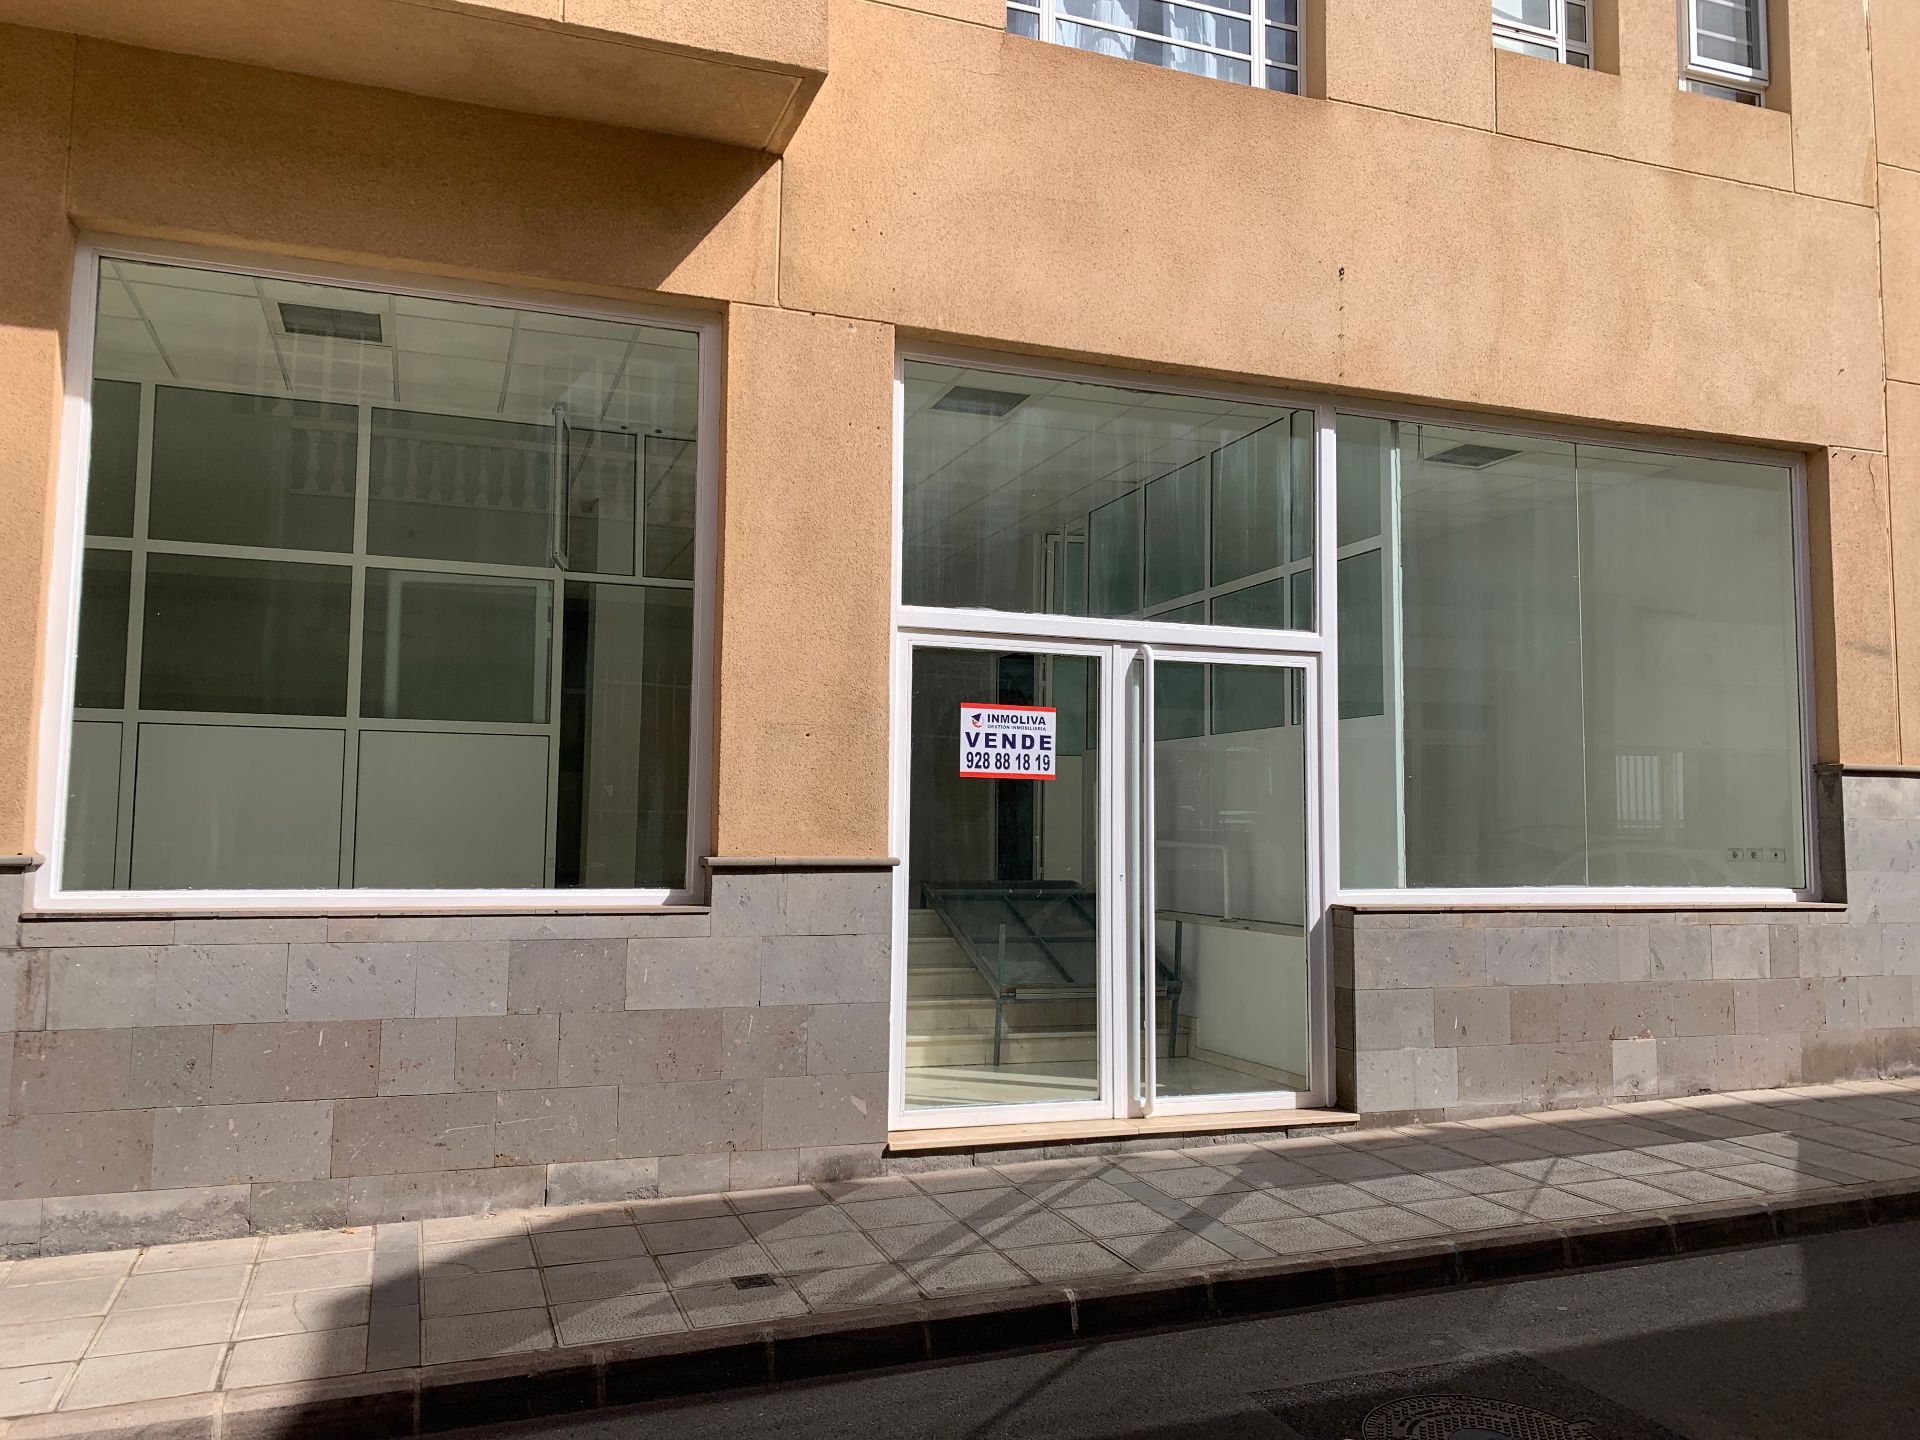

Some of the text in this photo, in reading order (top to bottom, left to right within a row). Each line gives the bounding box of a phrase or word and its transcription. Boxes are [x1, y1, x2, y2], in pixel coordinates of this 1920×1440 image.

[987, 713, 1046, 725] INMOLIVA
[965, 732, 1051, 750] VENDE
[966, 752, 1050, 771] 928 88 18 19
